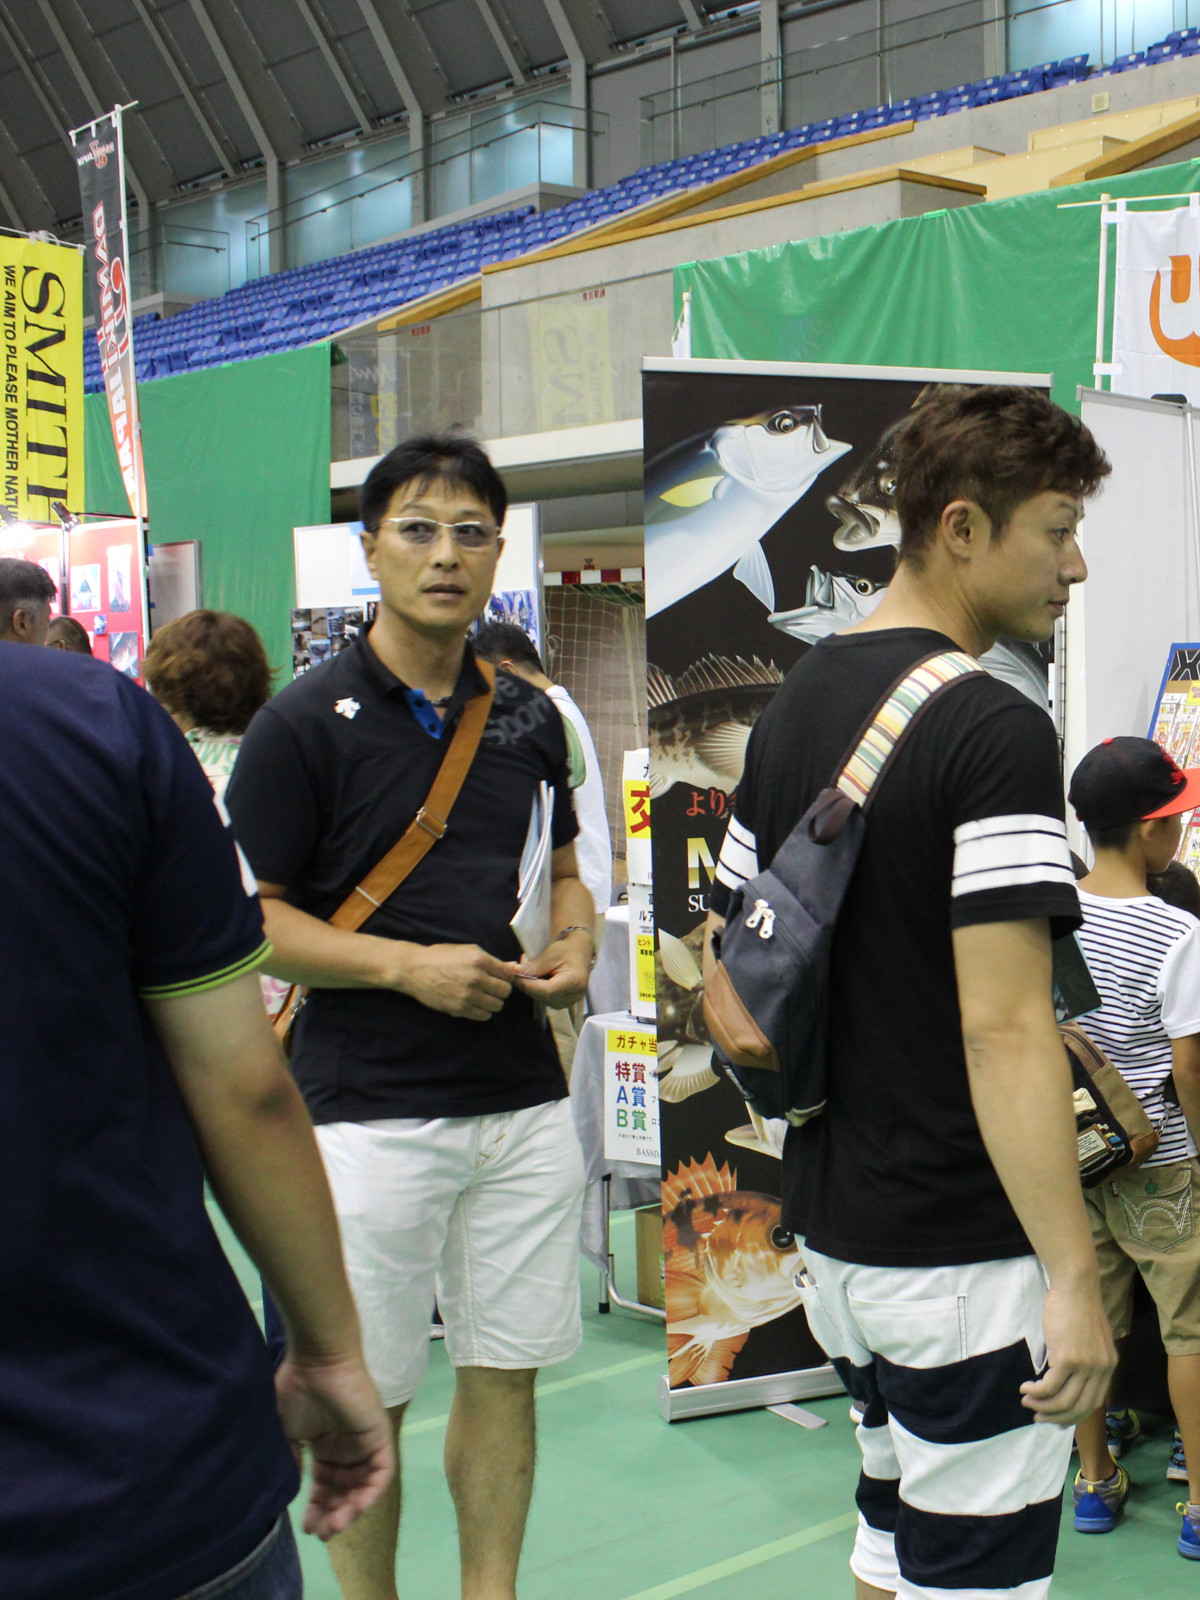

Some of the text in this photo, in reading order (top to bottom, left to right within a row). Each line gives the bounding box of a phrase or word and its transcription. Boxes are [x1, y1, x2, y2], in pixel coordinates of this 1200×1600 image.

[3, 264, 19, 521] WE AIM TO PLEASE MOTHER NATU
[638, 938, 651, 947] ヒント
[616, 1034, 658, 1053] ガチャ当
[615, 1061, 646, 1084] 特賞
